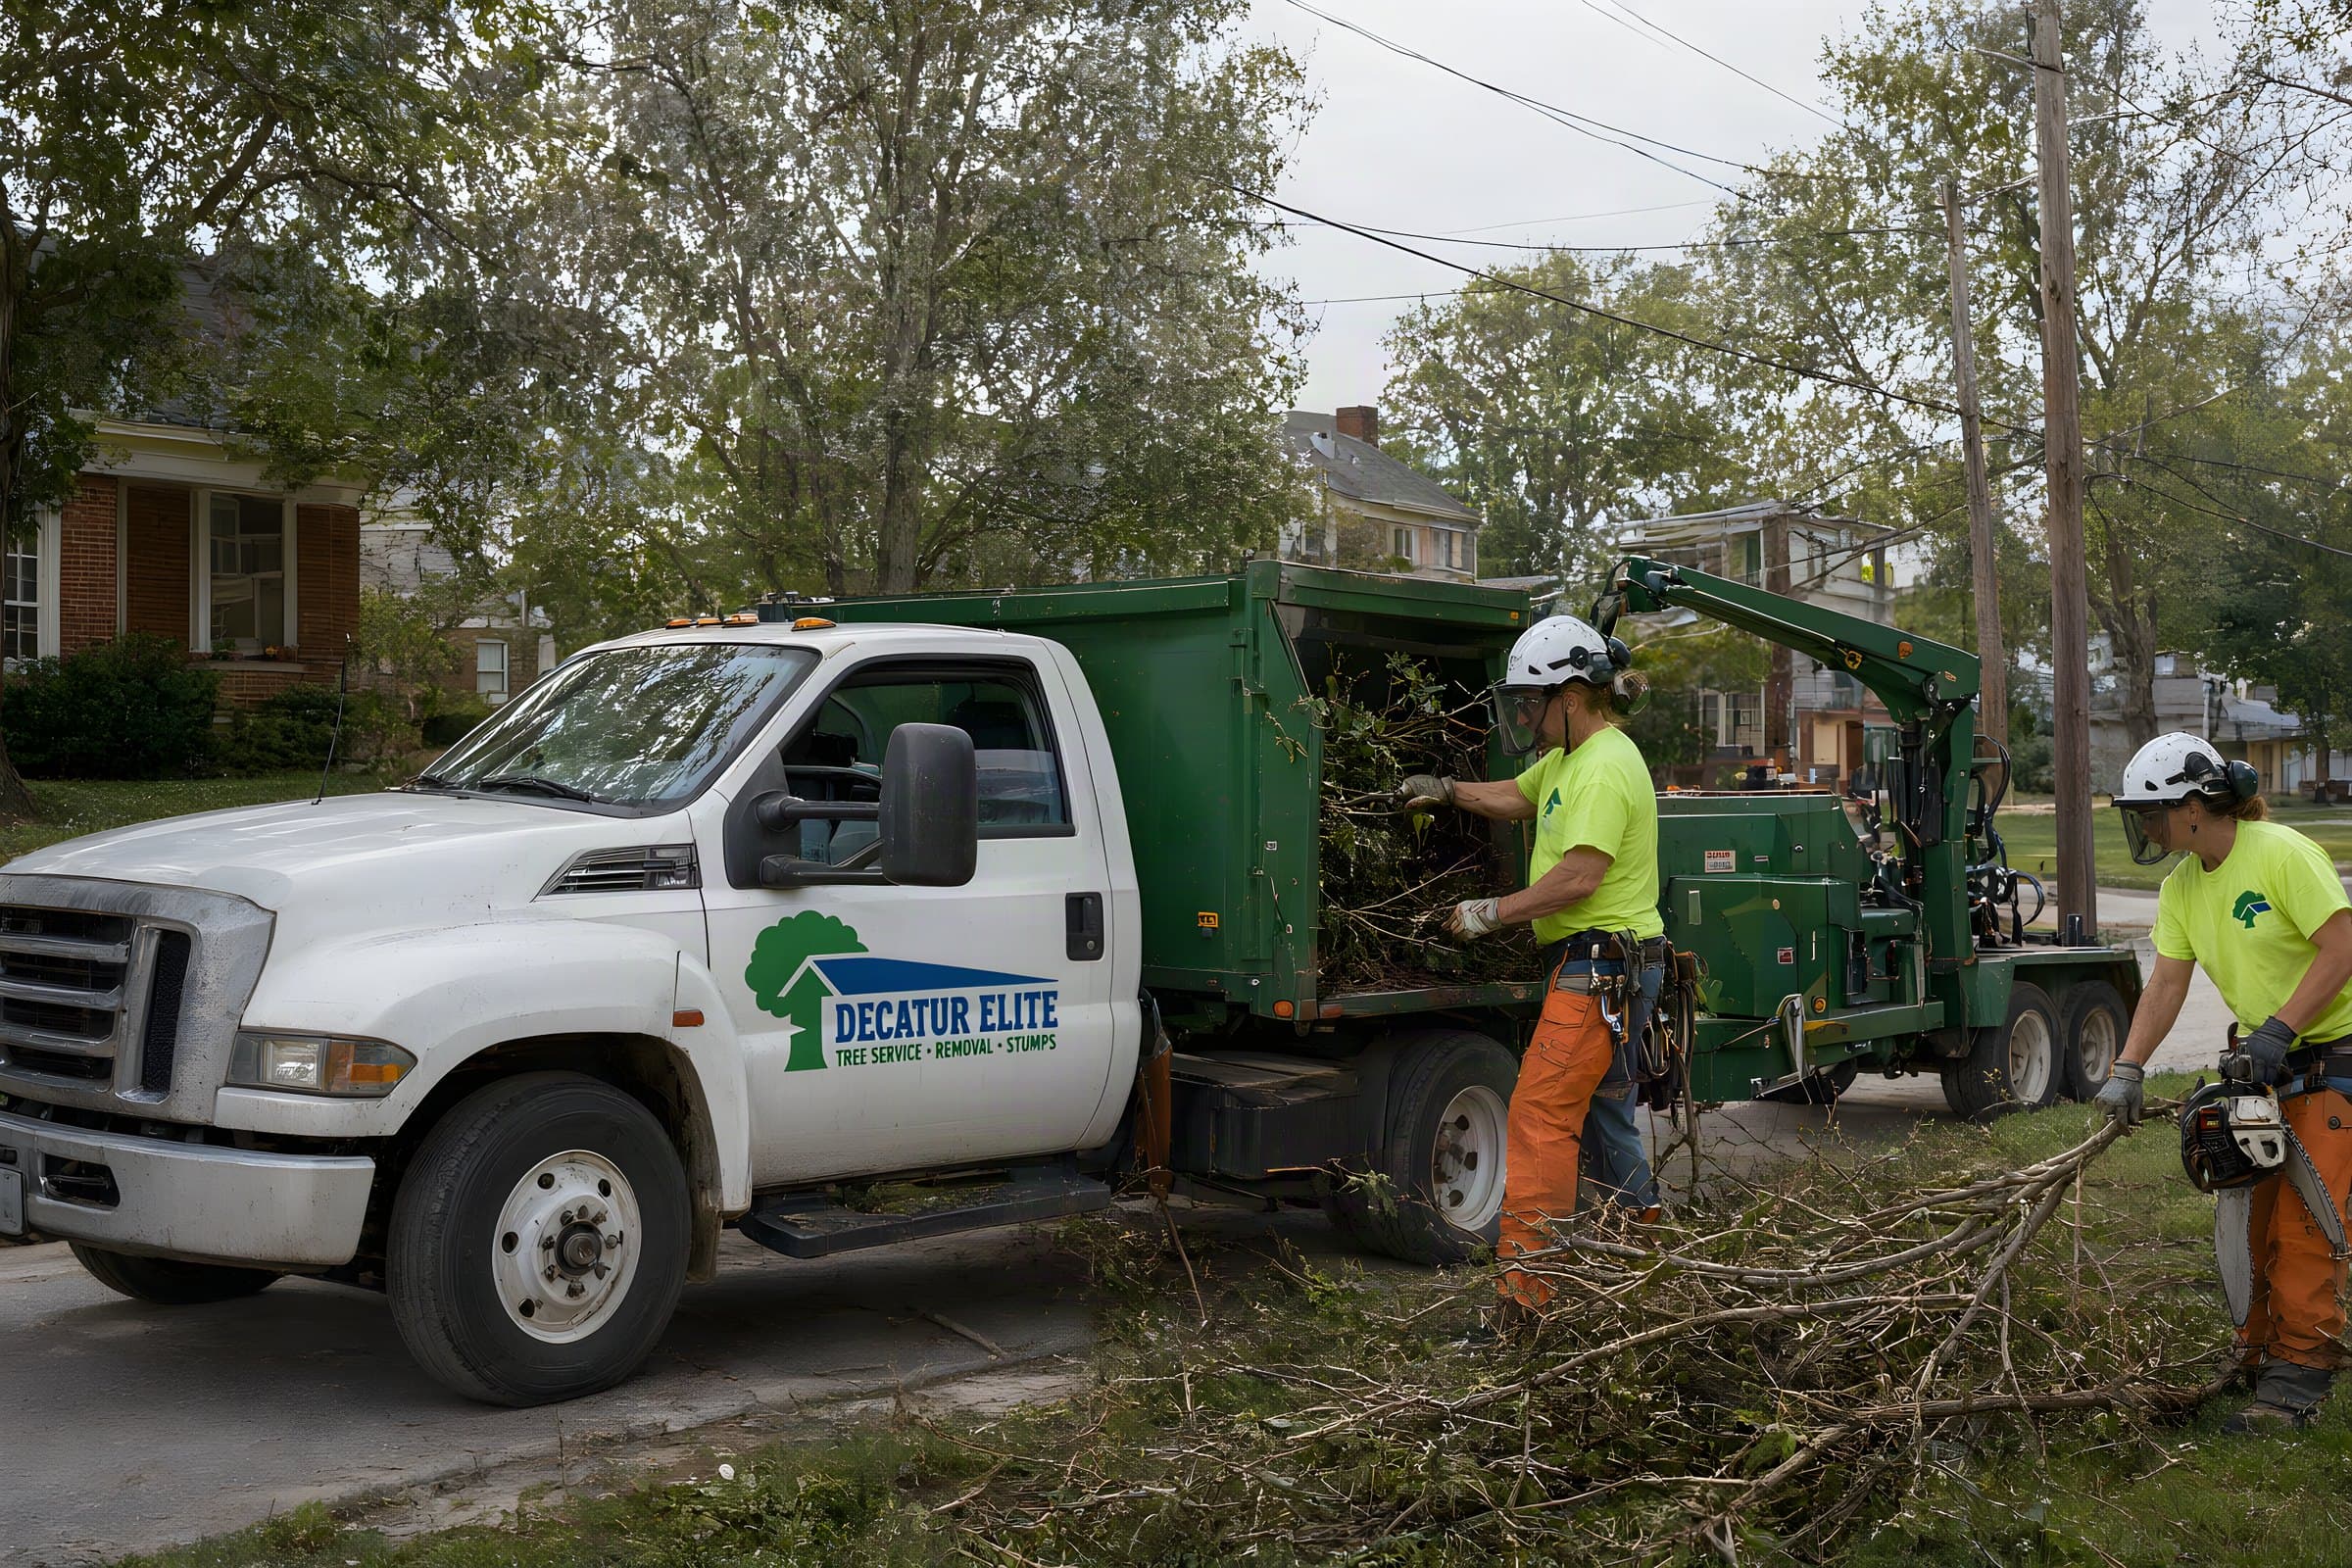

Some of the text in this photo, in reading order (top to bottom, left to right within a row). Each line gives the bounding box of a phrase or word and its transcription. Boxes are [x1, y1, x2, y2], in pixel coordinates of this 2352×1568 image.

[835, 991, 1058, 1043] DECATUR ELITE
[836, 1034, 1056, 1066] TREE SERVICE REMOVAL STUMPS
